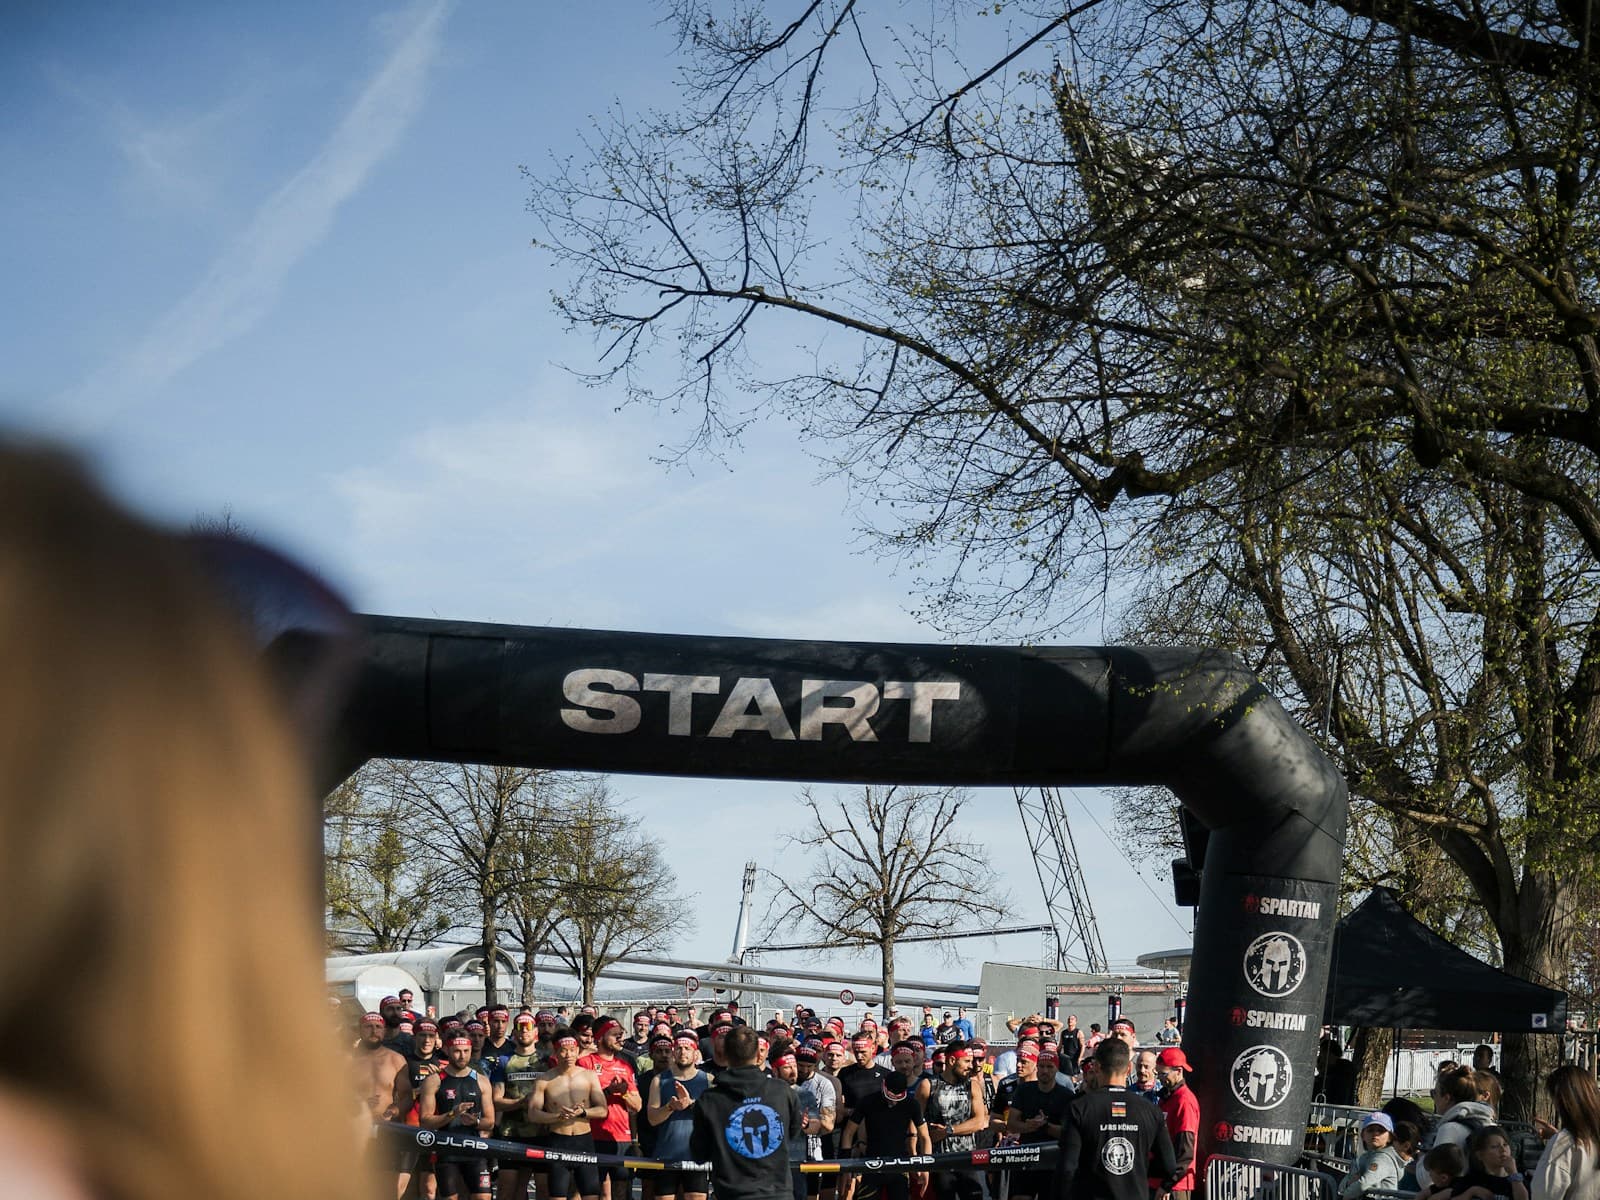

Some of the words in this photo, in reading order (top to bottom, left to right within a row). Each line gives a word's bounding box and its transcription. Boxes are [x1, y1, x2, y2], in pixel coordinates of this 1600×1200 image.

[560, 668, 960, 742] START
[1259, 897, 1321, 920] SPARTAN
[1246, 1009, 1308, 1032] SPARTAN
[1233, 1124, 1293, 1146] SPARTAN
[436, 1137, 489, 1150] JLAB
[990, 1146, 1041, 1156] Comunidad
[561, 1152, 598, 1164] Madrid
[885, 1156, 935, 1165] JLAB
[990, 1156, 1003, 1164] de
[1005, 1154, 1040, 1163] Madrid
